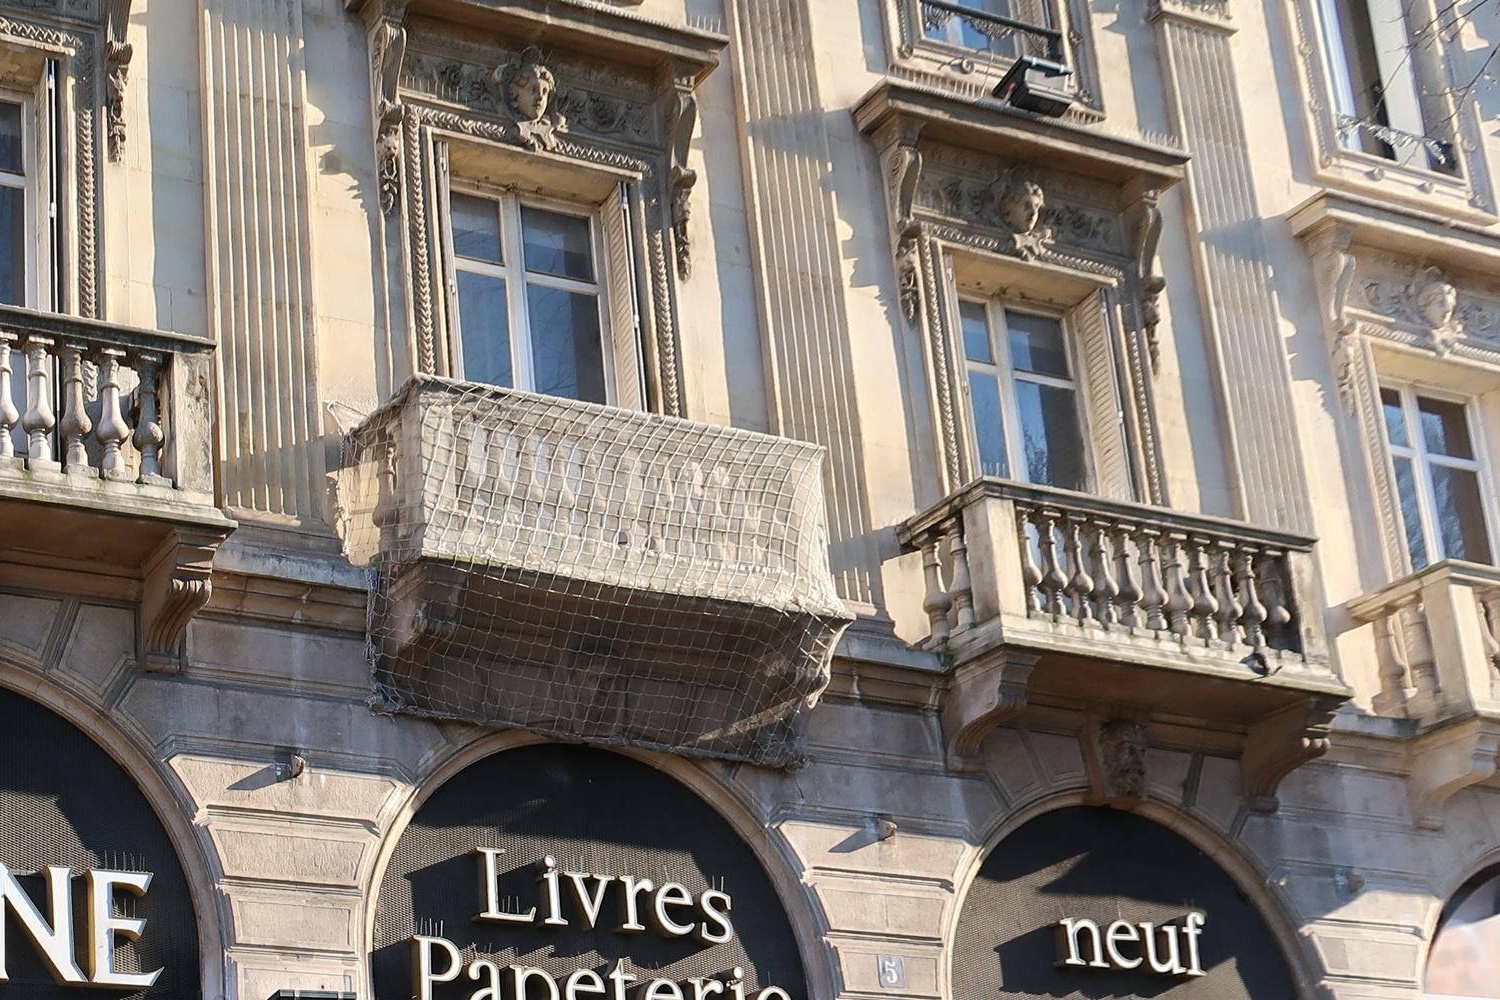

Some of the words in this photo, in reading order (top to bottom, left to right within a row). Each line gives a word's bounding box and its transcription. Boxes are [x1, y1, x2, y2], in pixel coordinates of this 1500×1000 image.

[474, 846, 733, 944] Livres
[883, 960, 898, 983] 5
[1056, 911, 1207, 977] neuf
